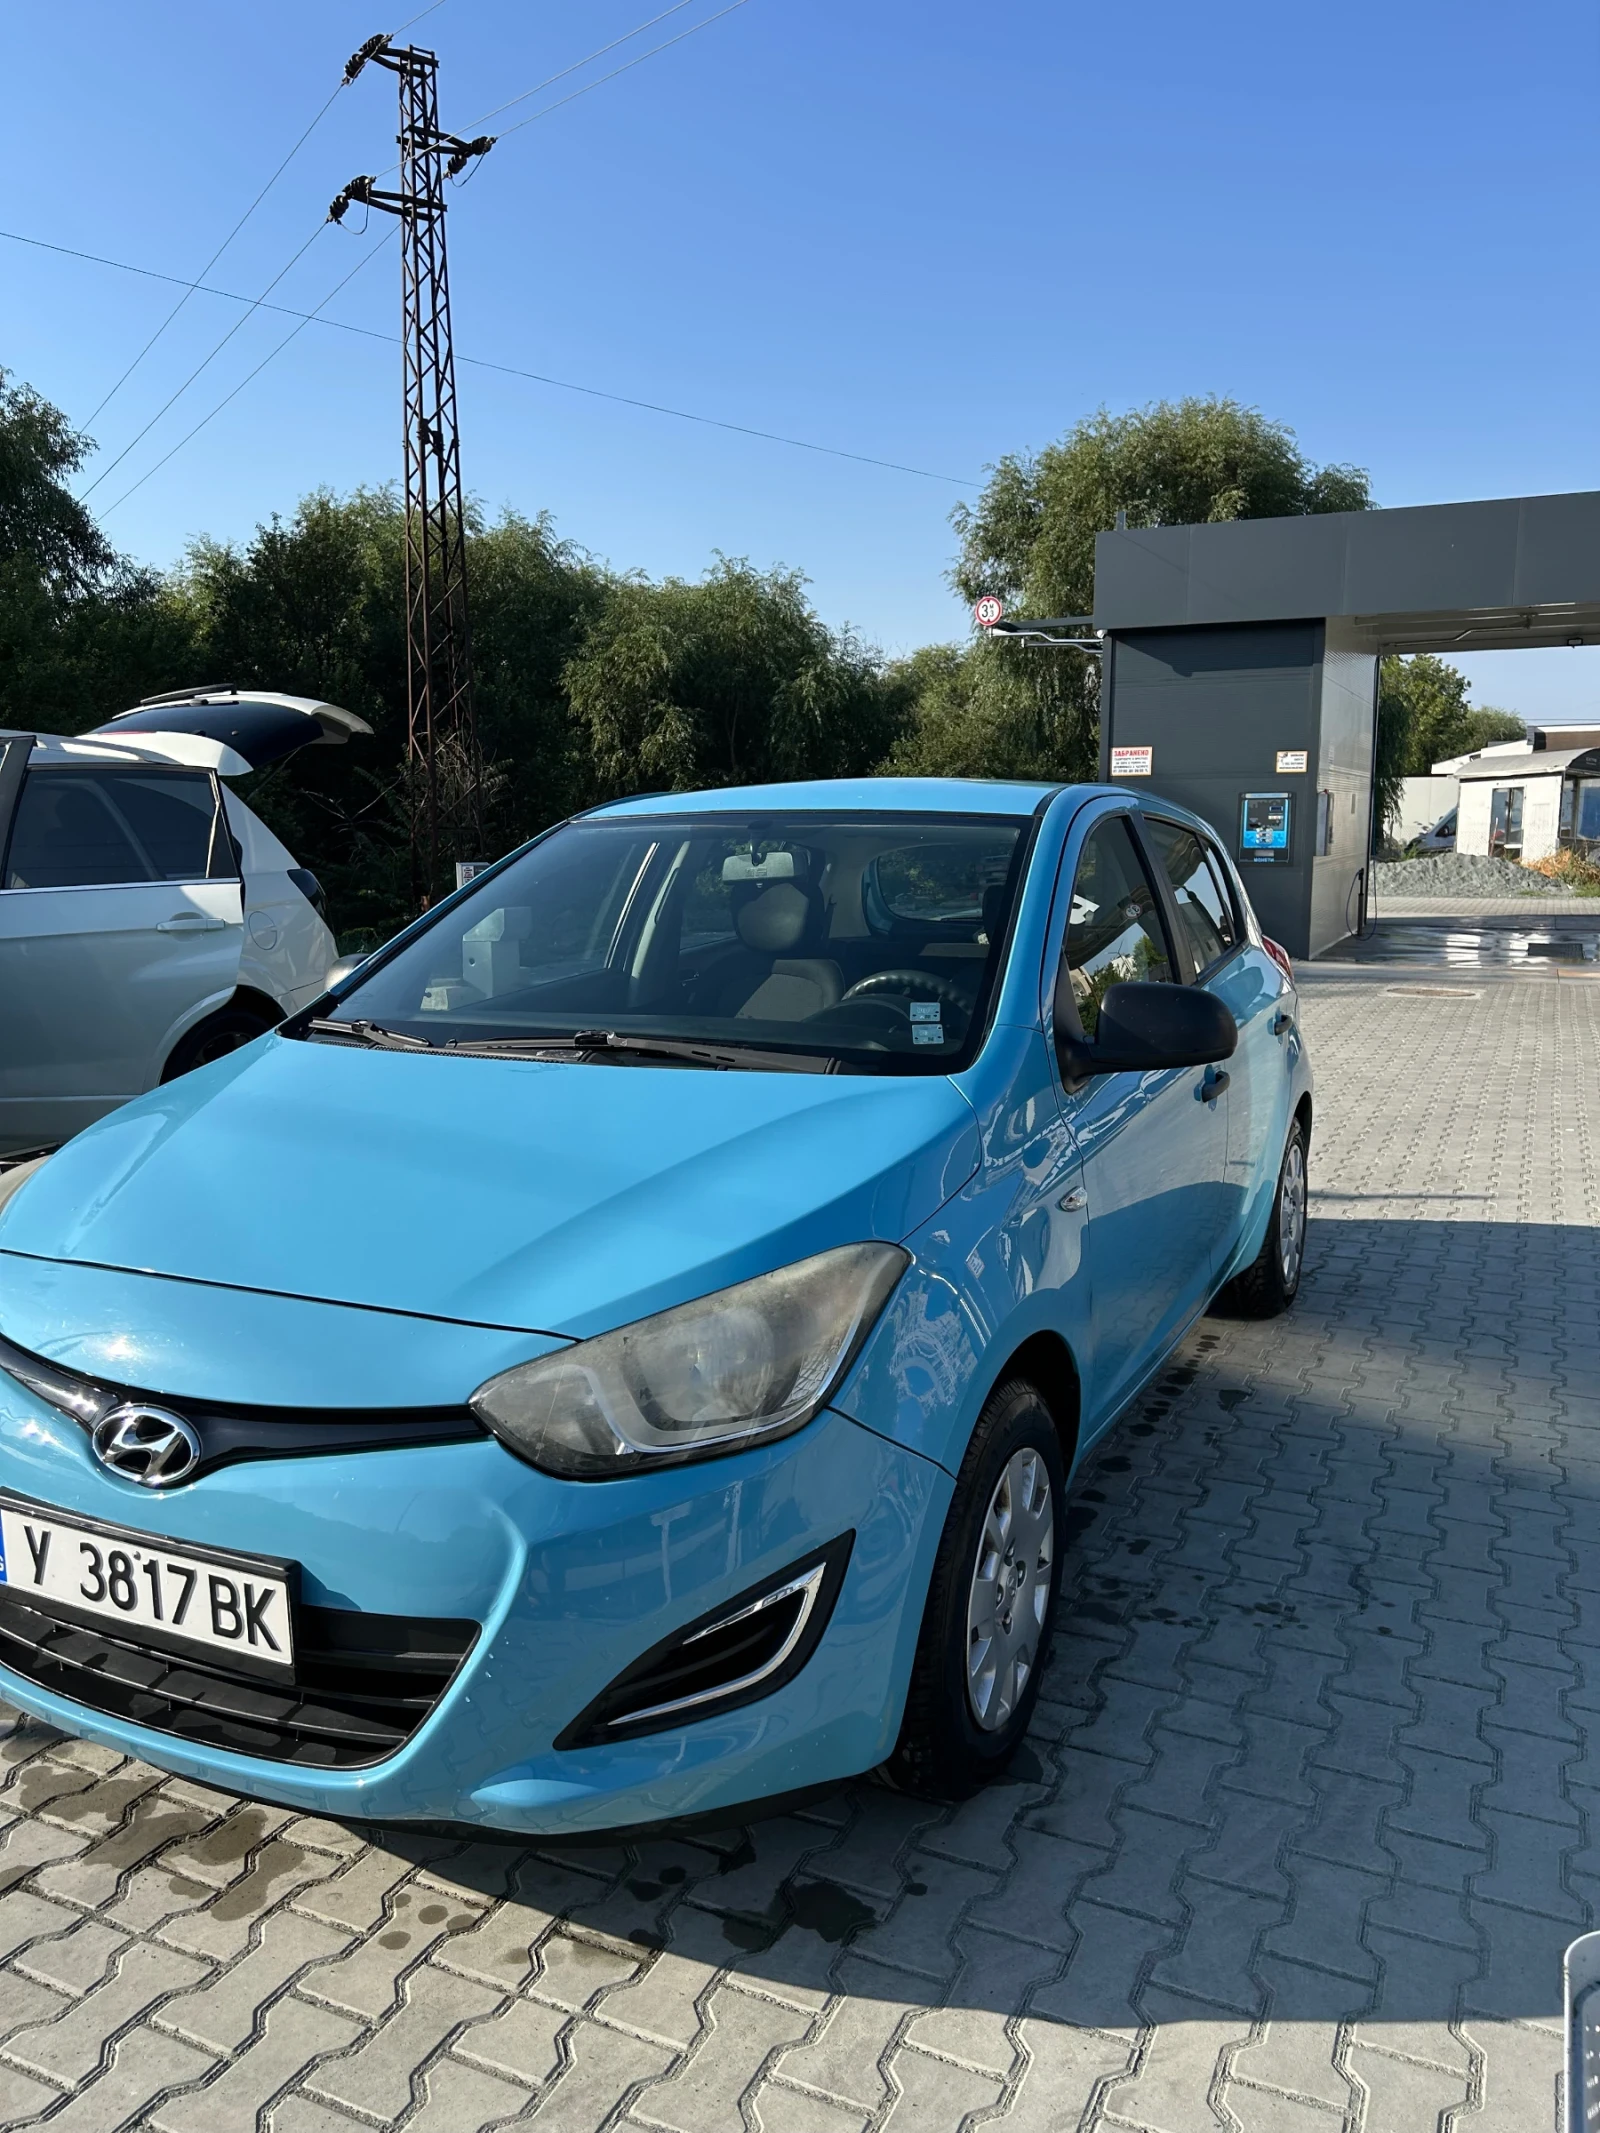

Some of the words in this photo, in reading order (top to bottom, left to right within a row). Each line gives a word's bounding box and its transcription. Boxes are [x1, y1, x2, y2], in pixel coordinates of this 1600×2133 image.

[982, 604, 988, 617] 3
[23, 1525, 51, 1585] Y
[79, 1542, 198, 1626] 3817
[208, 1574, 282, 1652] BK
